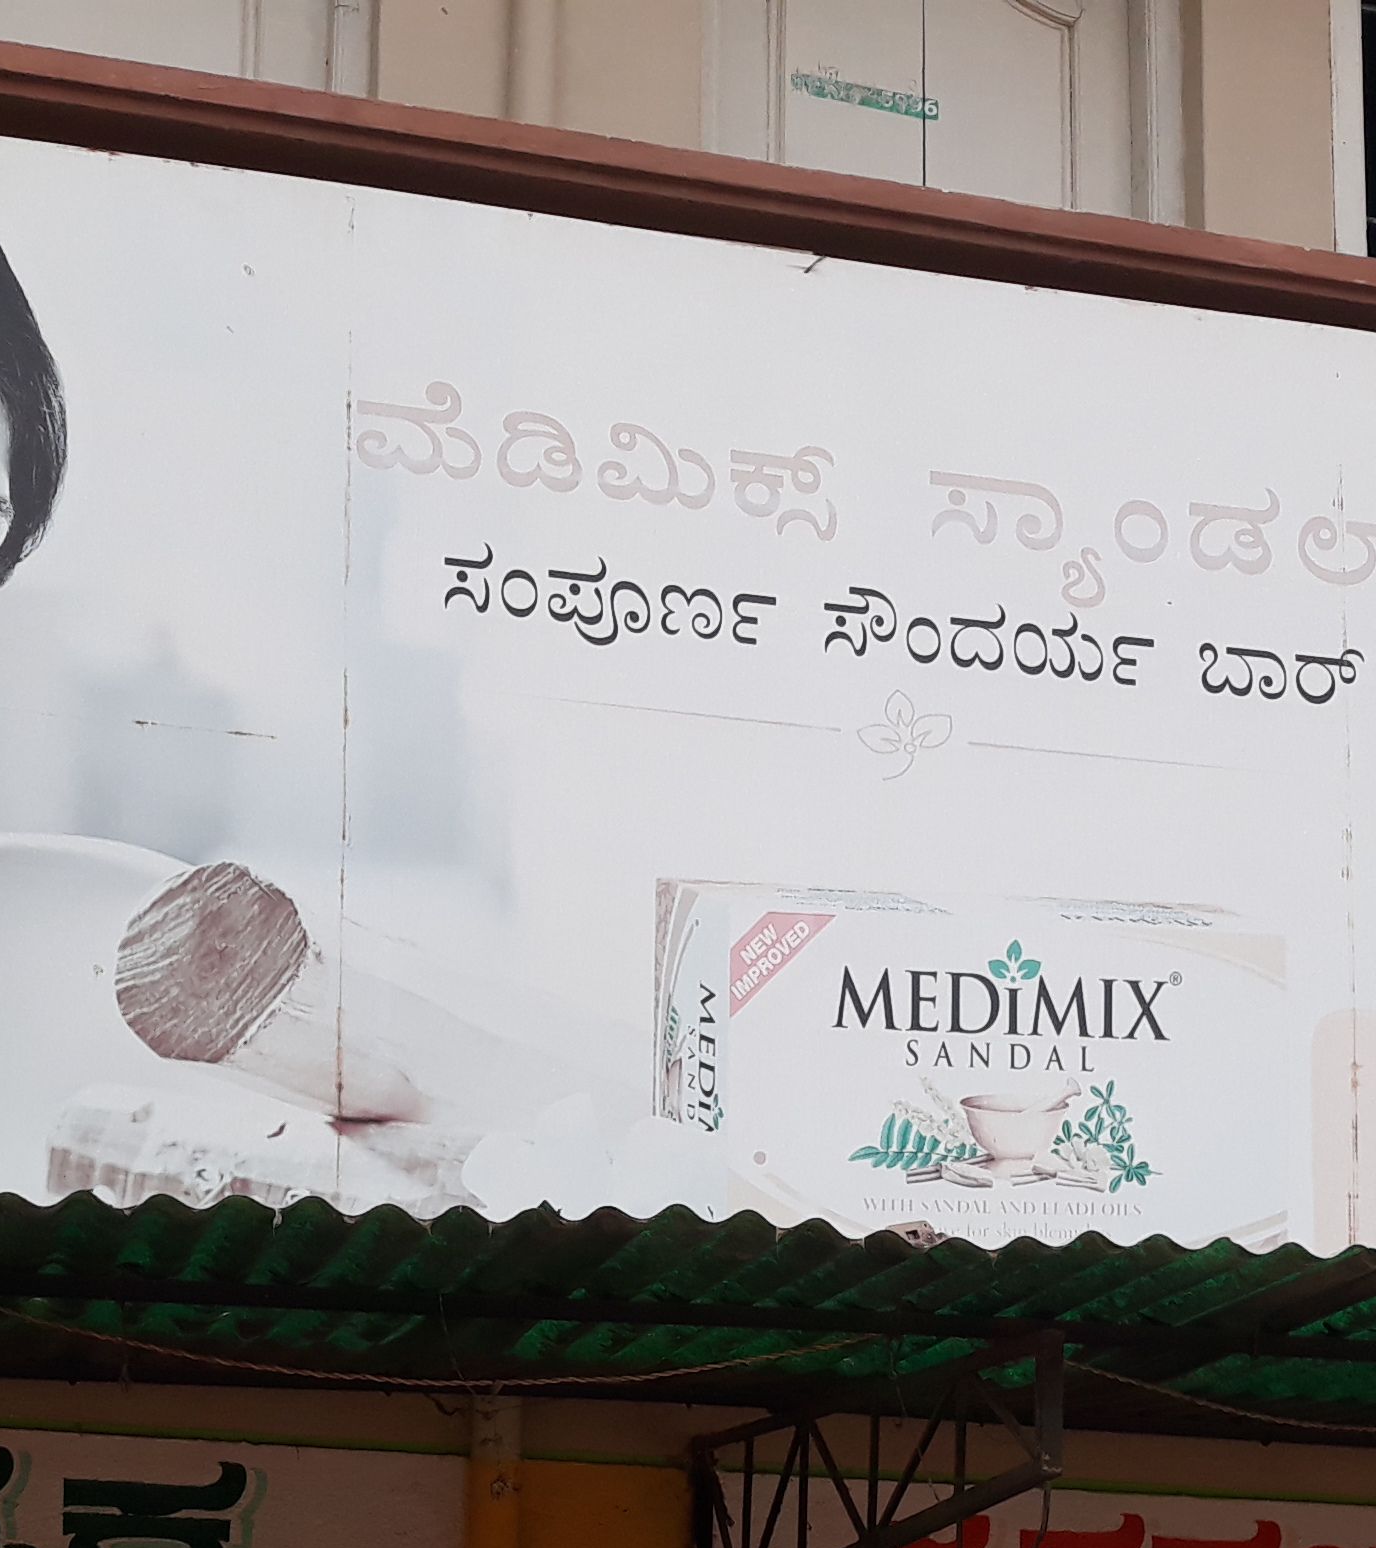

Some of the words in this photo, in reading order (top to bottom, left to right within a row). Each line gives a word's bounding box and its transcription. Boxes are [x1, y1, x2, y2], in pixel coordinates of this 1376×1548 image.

[356, 381, 838, 542] ಮೆಡಿಮಿಕ್ಸ್
[444, 542, 777, 646] ಸಂಪೂರ್ಣ
[823, 586, 1155, 686] ಸೌಂದರ್ಯ
[1199, 642, 1365, 704] ಬಾರ್
[730, 920, 811, 1001] IMPROVED
[739, 923, 779, 966] NEW
[905, 1039, 1095, 1073] SANDAL
